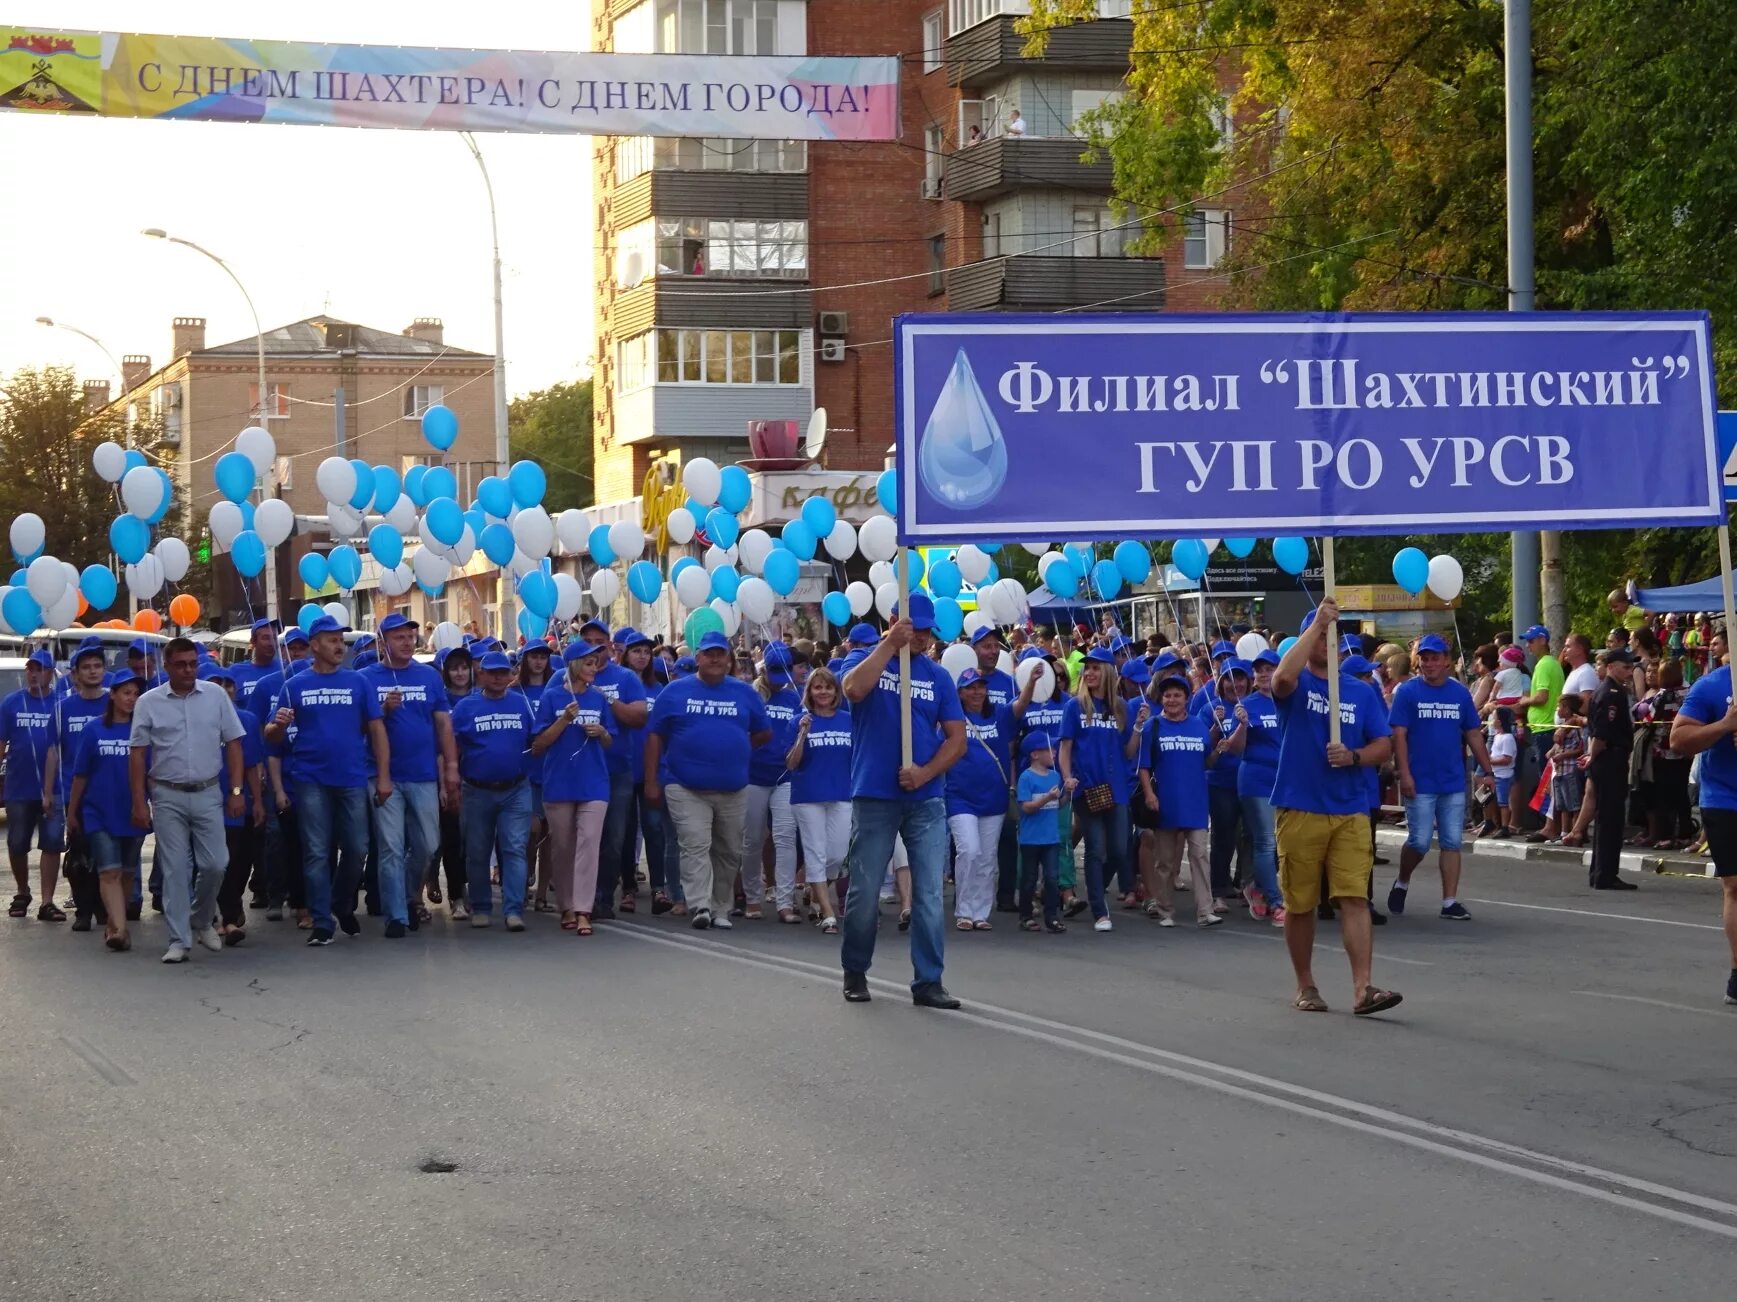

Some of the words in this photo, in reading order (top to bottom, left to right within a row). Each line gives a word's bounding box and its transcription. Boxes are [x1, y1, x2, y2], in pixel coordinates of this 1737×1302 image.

[138, 62, 162, 92] С
[172, 65, 302, 99] ДНЕМ
[312, 70, 525, 107] ШАХТЕРА!
[538, 78, 561, 109] С
[571, 80, 692, 115] ДНЕМ
[702, 83, 870, 118] ГОРОДА!
[998, 361, 1241, 413] Филиал
[1134, 440, 1278, 493] ГУП
[1295, 438, 1384, 491] РО
[1399, 435, 1575, 489] УРСВ
